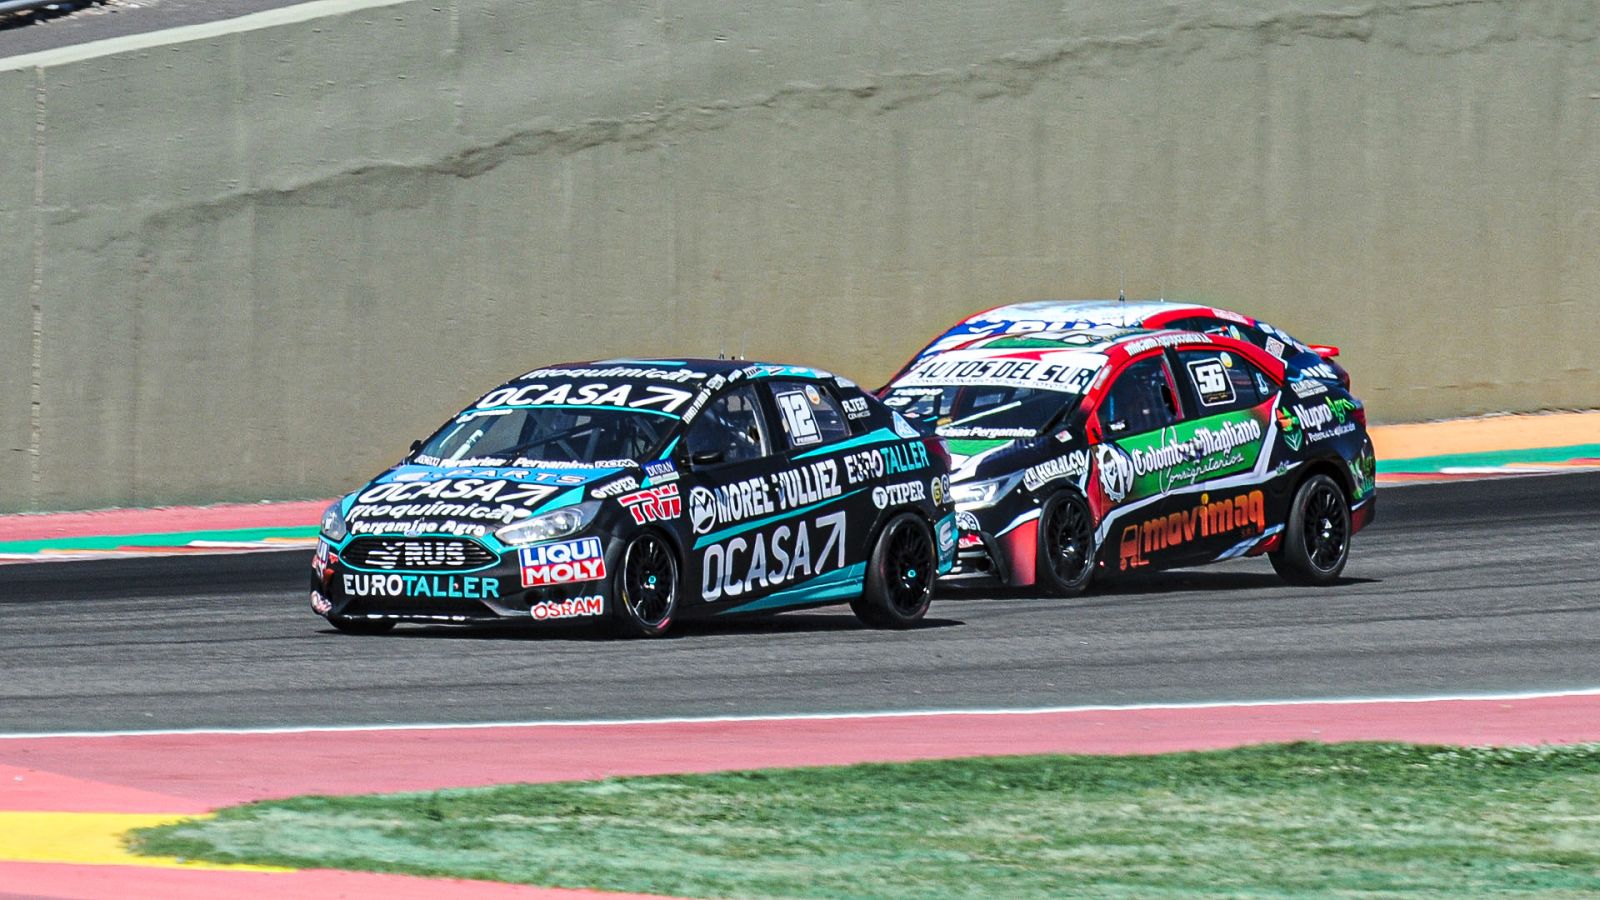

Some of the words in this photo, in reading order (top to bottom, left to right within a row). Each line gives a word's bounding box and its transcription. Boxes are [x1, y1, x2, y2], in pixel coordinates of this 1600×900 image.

[917, 360, 998, 378] AUTOS
[990, 360, 1038, 380] DEL
[1037, 364, 1091, 386] SUR
[1195, 363, 1226, 394] 56
[476, 383, 632, 409] OCASA
[779, 394, 817, 438] 12
[1194, 419, 1261, 456] Magliano
[1037, 450, 1085, 480] HERALCO
[358, 479, 507, 503] OCASA
[617, 483, 681, 525] TRW
[714, 477, 774, 523] MOREL
[885, 480, 926, 506] TIPER
[438, 520, 485, 537] Agro
[1143, 490, 1265, 553] movimaq
[523, 539, 599, 567] LIQUI
[702, 520, 811, 602] OCASA
[343, 574, 499, 598] EUROTALLER
[525, 559, 601, 585] MOLY
[532, 596, 602, 620] OSRAM
